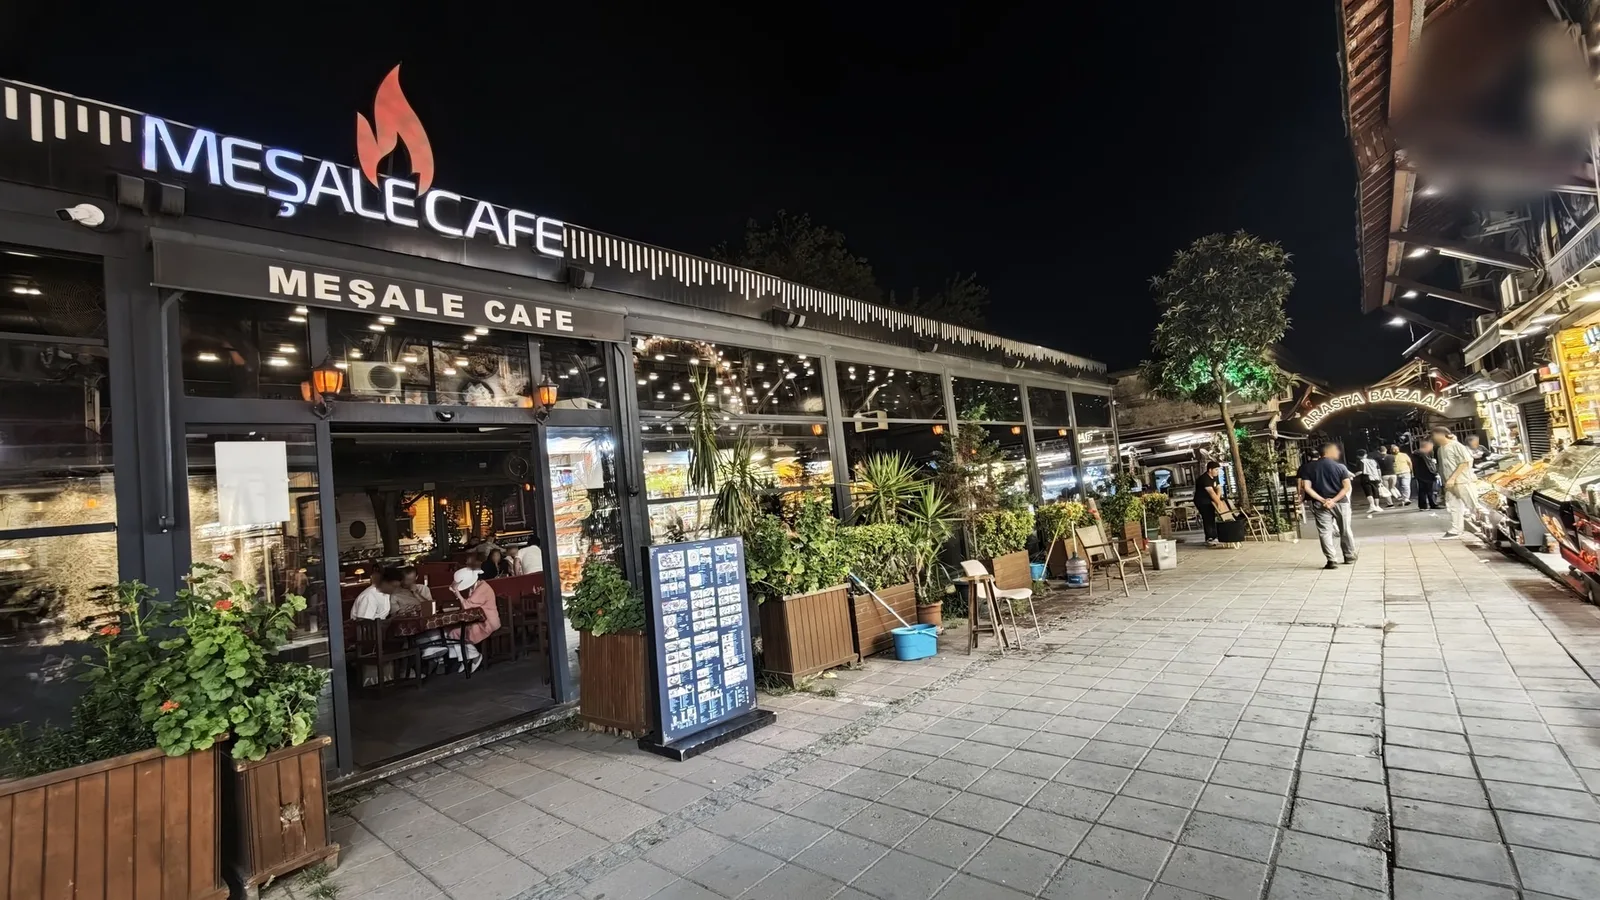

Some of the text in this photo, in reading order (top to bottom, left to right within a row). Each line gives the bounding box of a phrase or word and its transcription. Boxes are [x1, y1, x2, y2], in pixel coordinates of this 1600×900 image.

[142, 115, 565, 258] MEŞALE CAFE
[269, 266, 574, 332] MEŞALE CAFE
[1301, 388, 1450, 430] ARASTA BAZAAR
